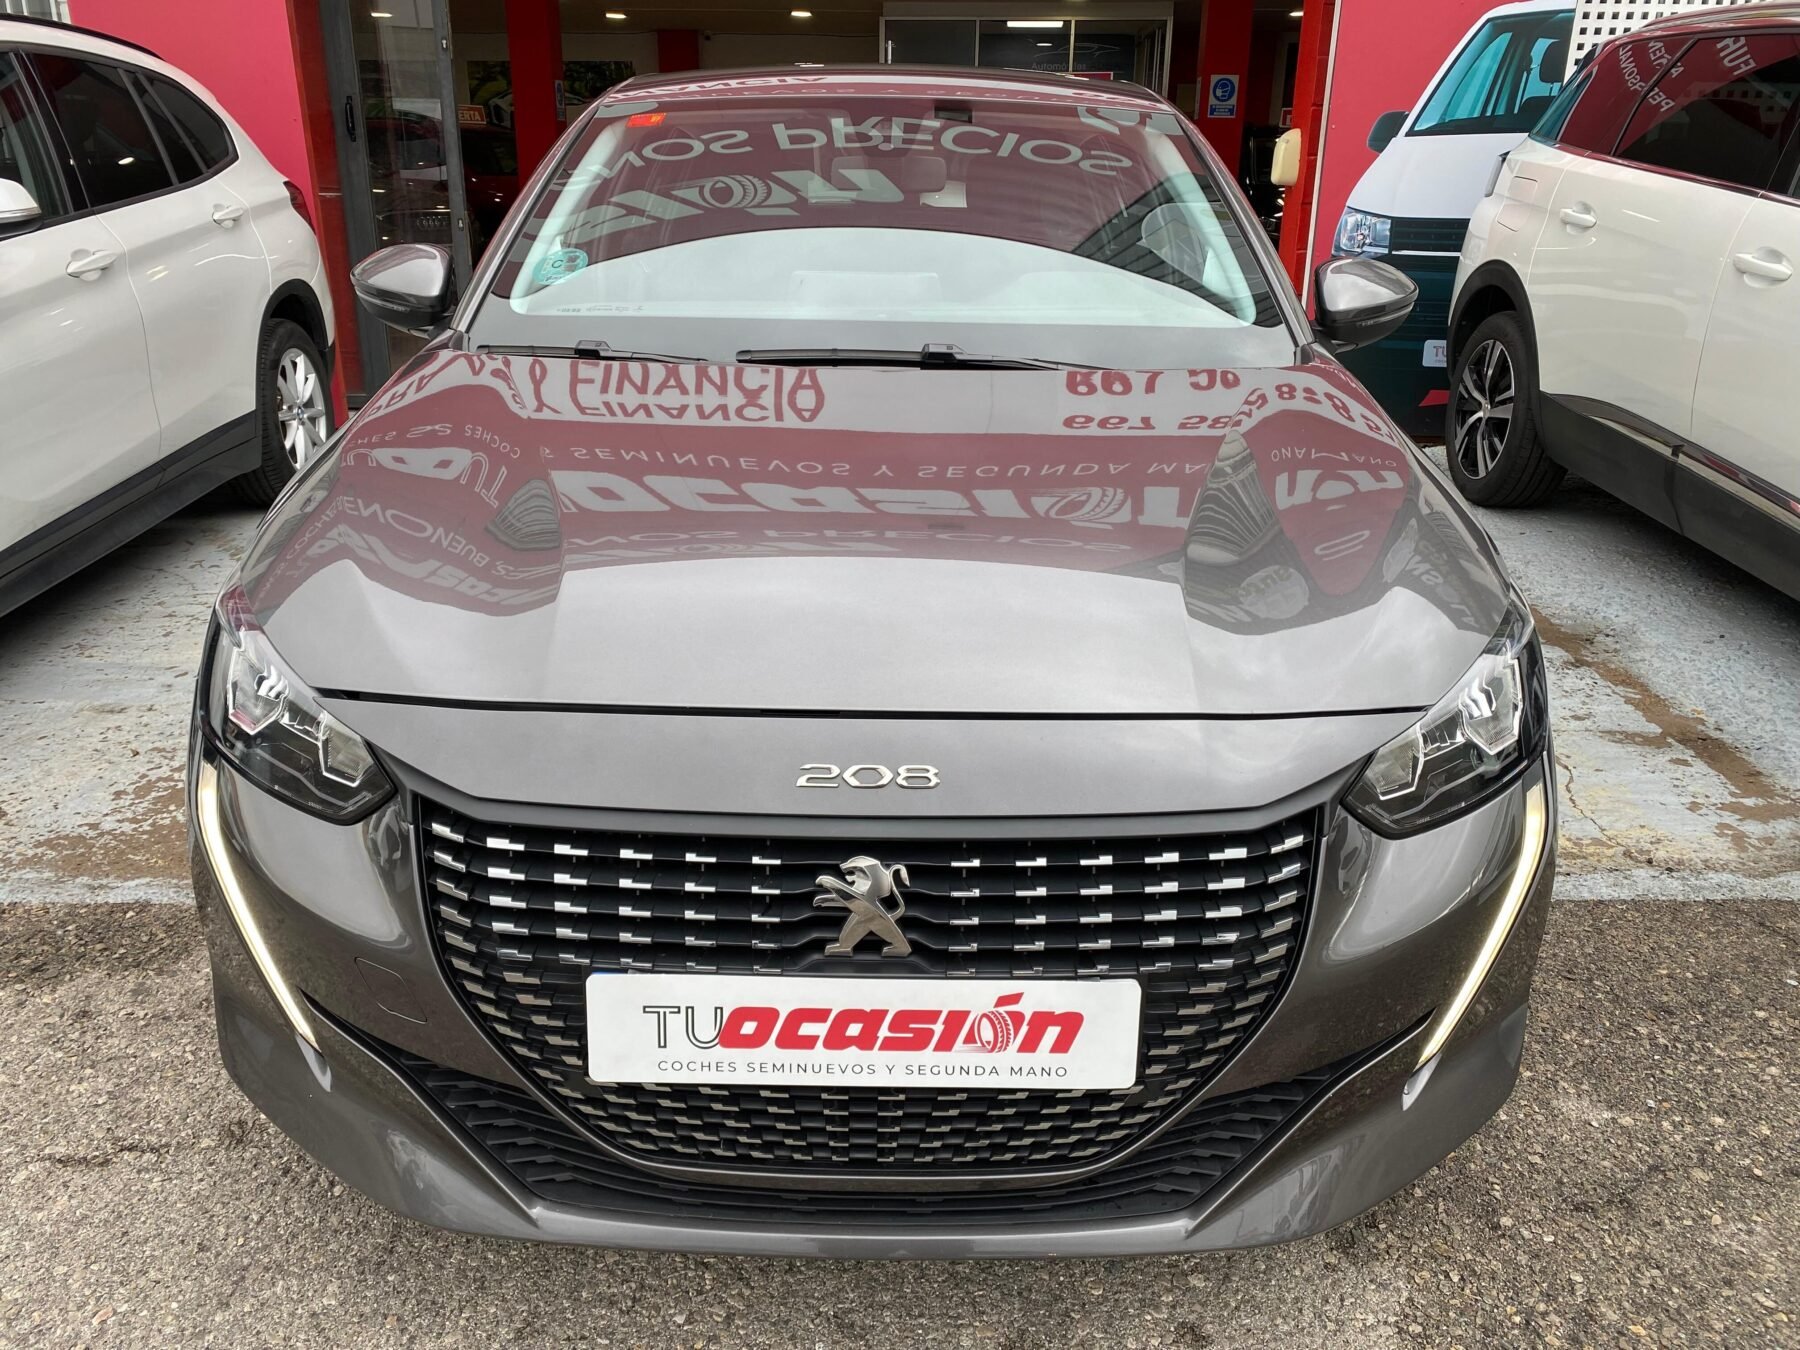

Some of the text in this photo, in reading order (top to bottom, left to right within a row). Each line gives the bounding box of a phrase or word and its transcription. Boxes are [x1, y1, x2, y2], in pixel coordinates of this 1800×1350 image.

[796, 763, 941, 789] 208
[657, 1060, 1069, 1078] COCHES SEMINUEVOS Y SEGUNDA MANO
